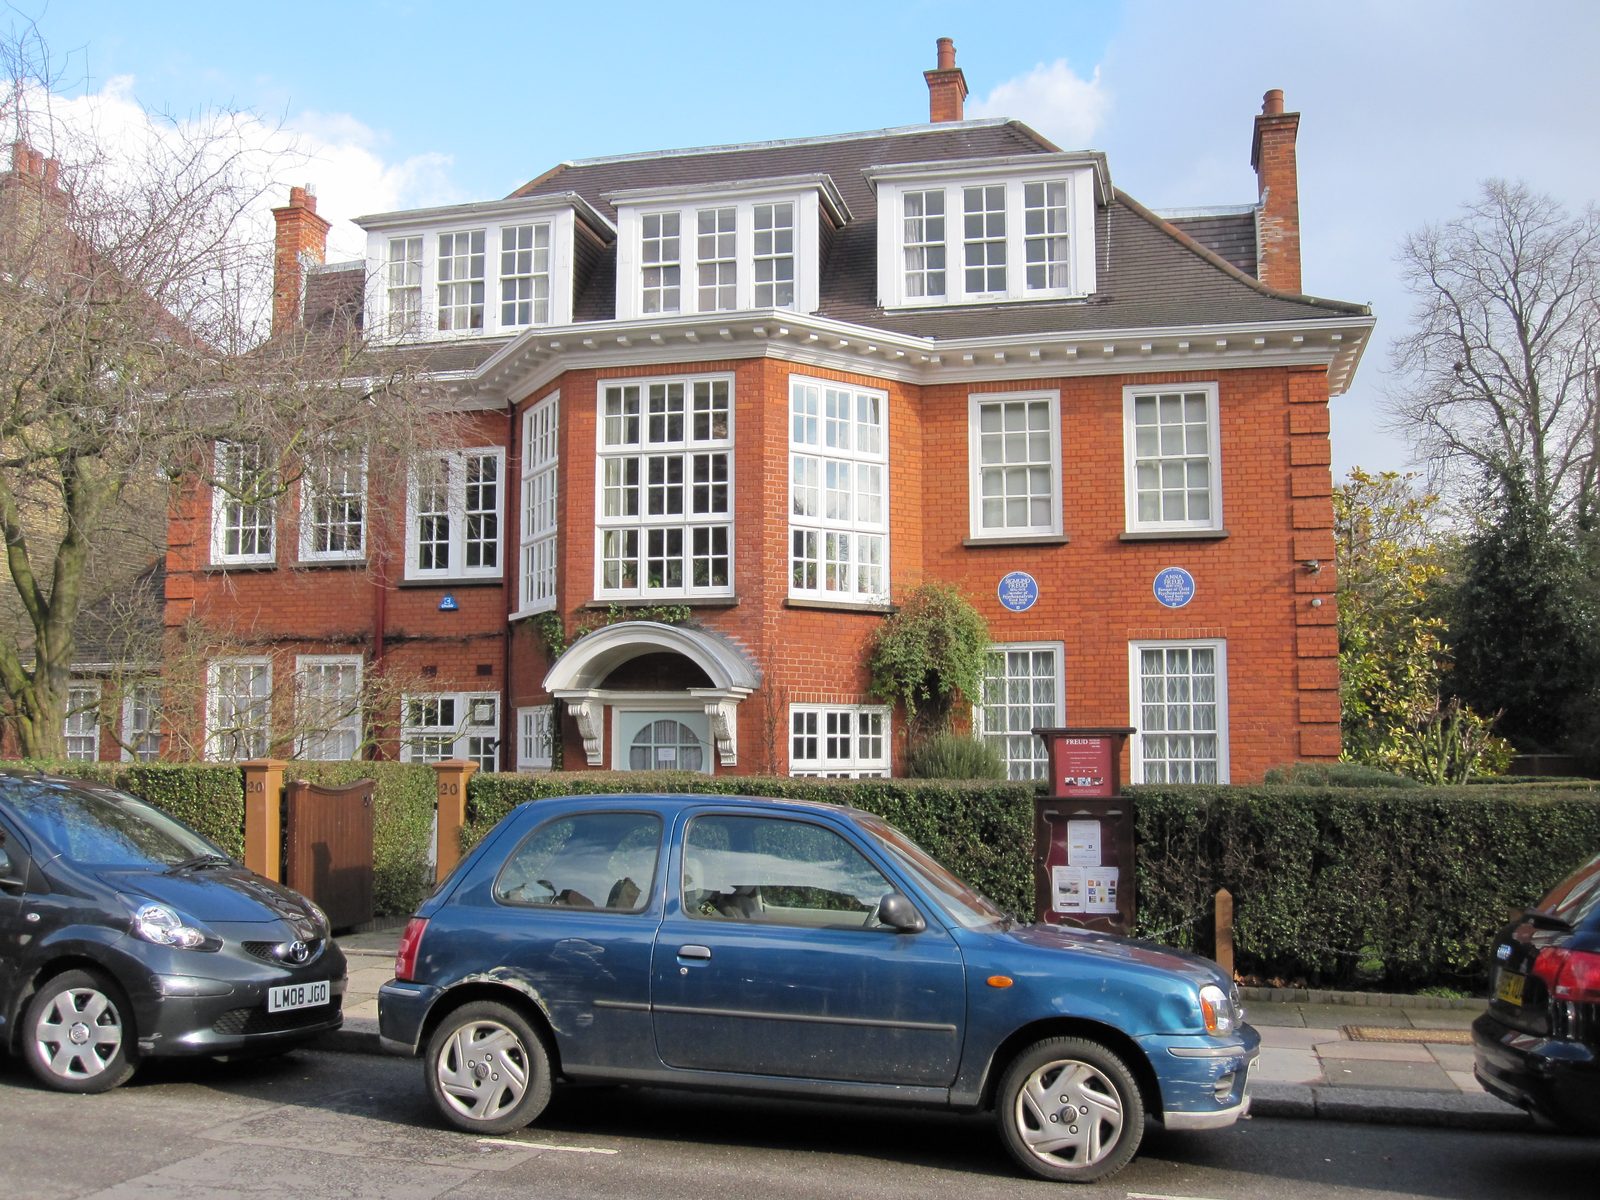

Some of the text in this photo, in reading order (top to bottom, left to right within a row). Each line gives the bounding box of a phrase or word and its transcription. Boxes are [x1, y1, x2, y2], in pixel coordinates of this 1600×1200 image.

[248, 781, 263, 793] 20
[441, 783, 458, 795] 20
[275, 984, 326, 1008] LM08 JGO
